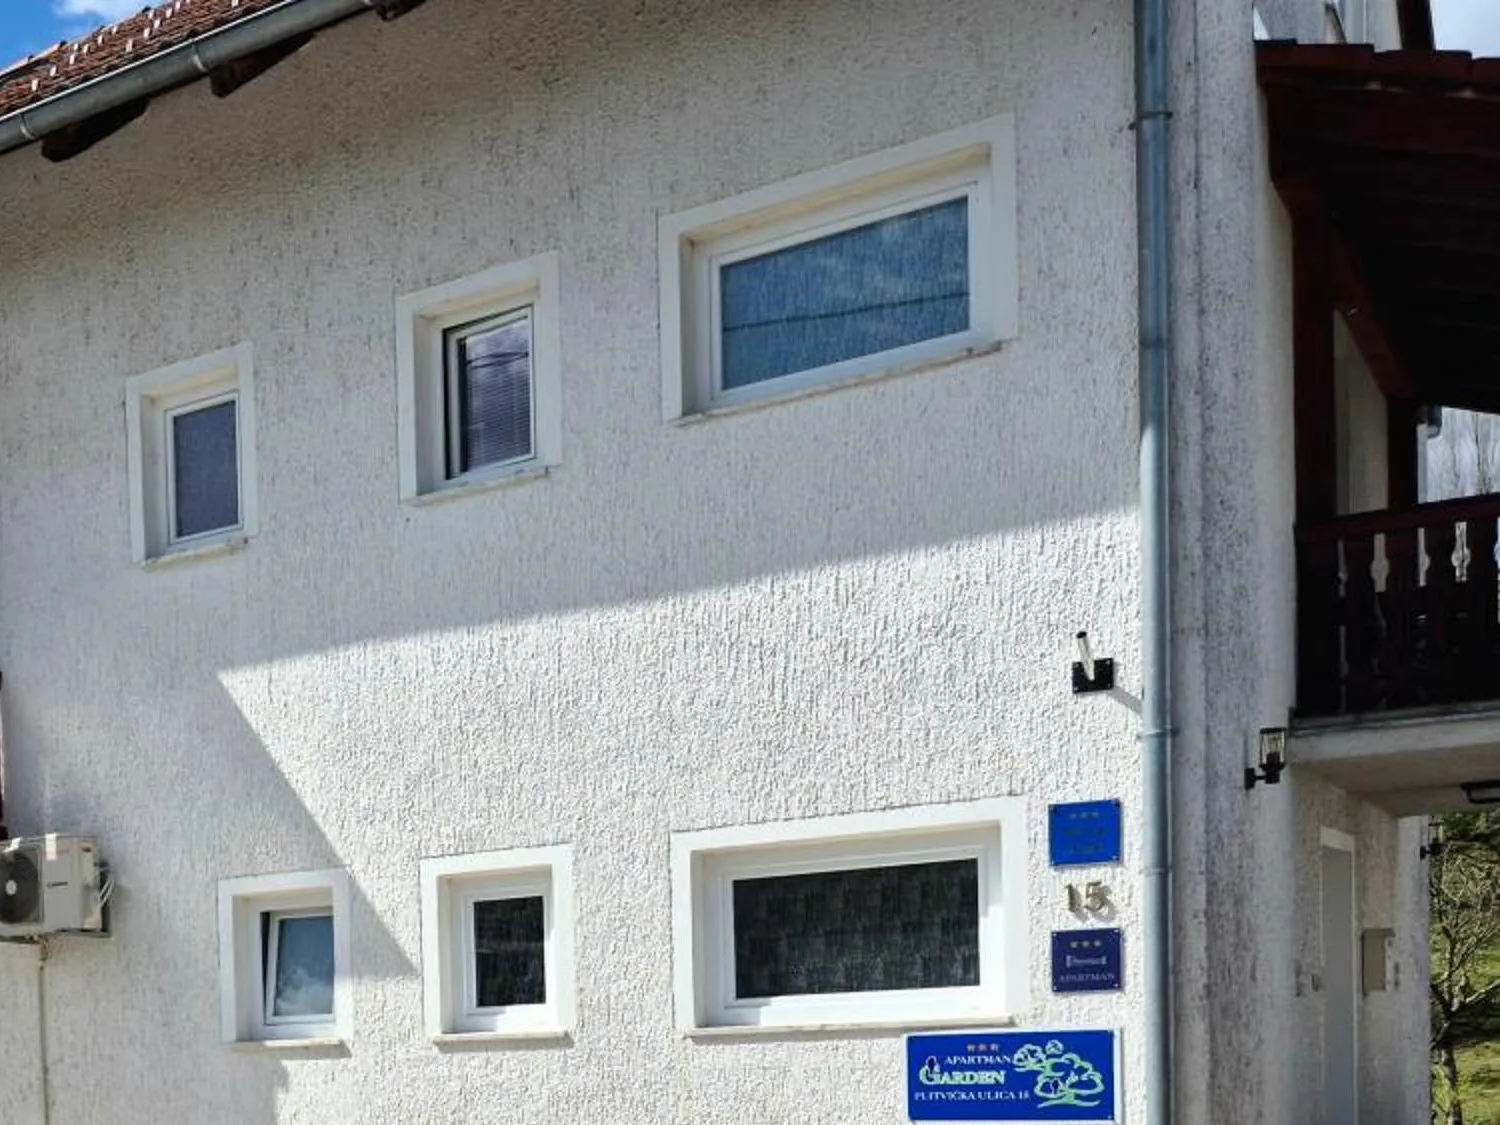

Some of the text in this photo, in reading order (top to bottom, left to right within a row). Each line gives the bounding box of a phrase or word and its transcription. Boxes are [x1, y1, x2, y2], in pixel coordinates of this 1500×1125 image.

[1064, 880, 1105, 912] 15
[943, 1055, 1012, 1065] APARTMAN
[977, 1090, 1015, 1101] ULICA
